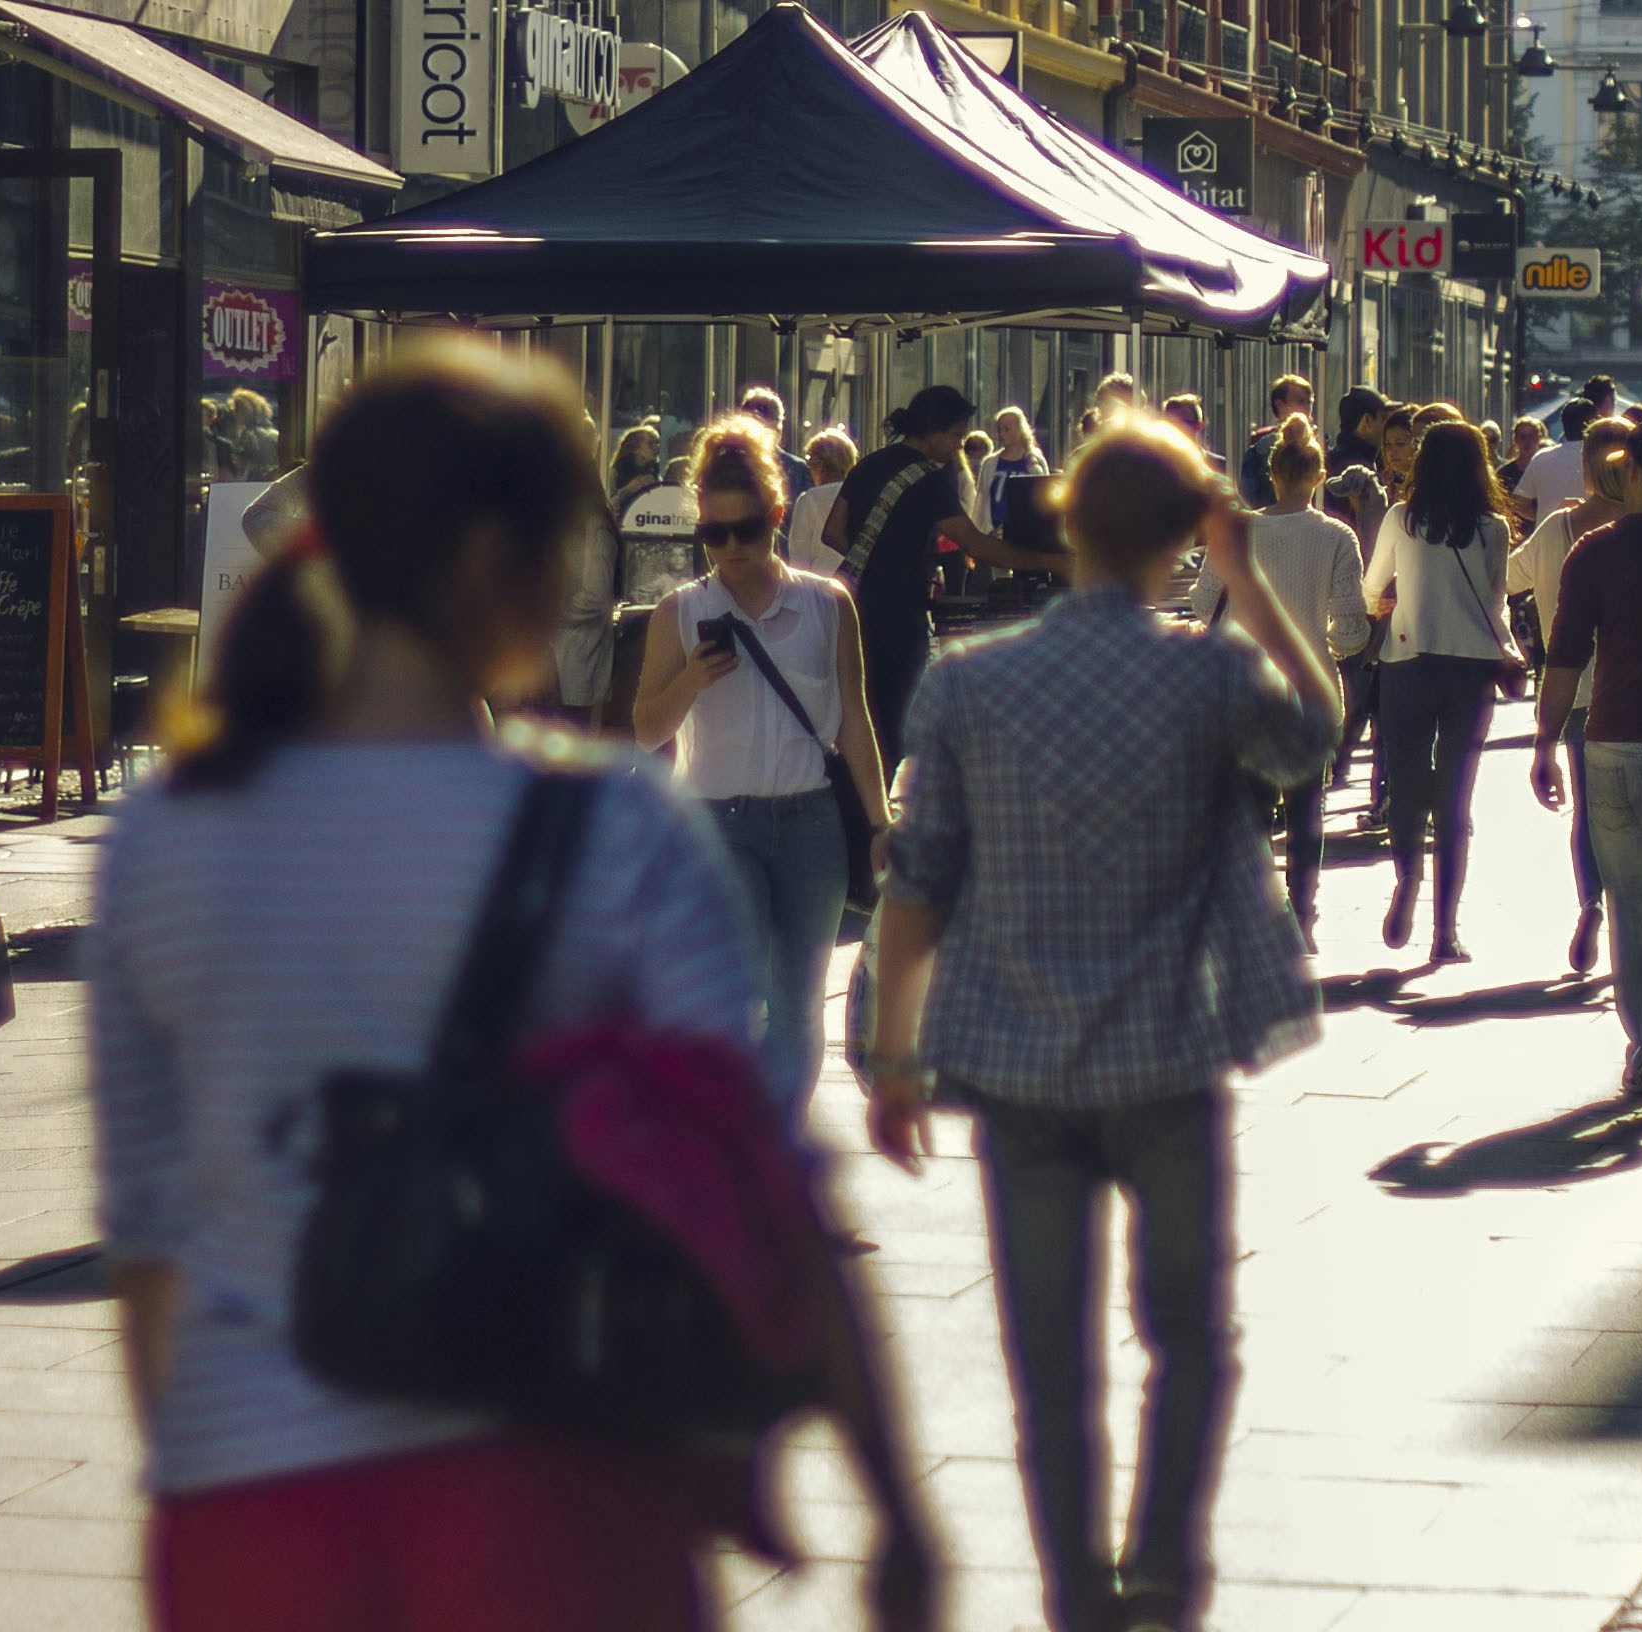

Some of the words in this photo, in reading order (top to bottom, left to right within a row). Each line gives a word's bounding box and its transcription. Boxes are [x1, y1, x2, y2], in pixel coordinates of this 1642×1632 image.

[520, 1, 623, 110] ginatricot
[1363, 226, 1443, 268] Kid
[1523, 254, 1592, 290] nille
[212, 305, 271, 353] OUTLET
